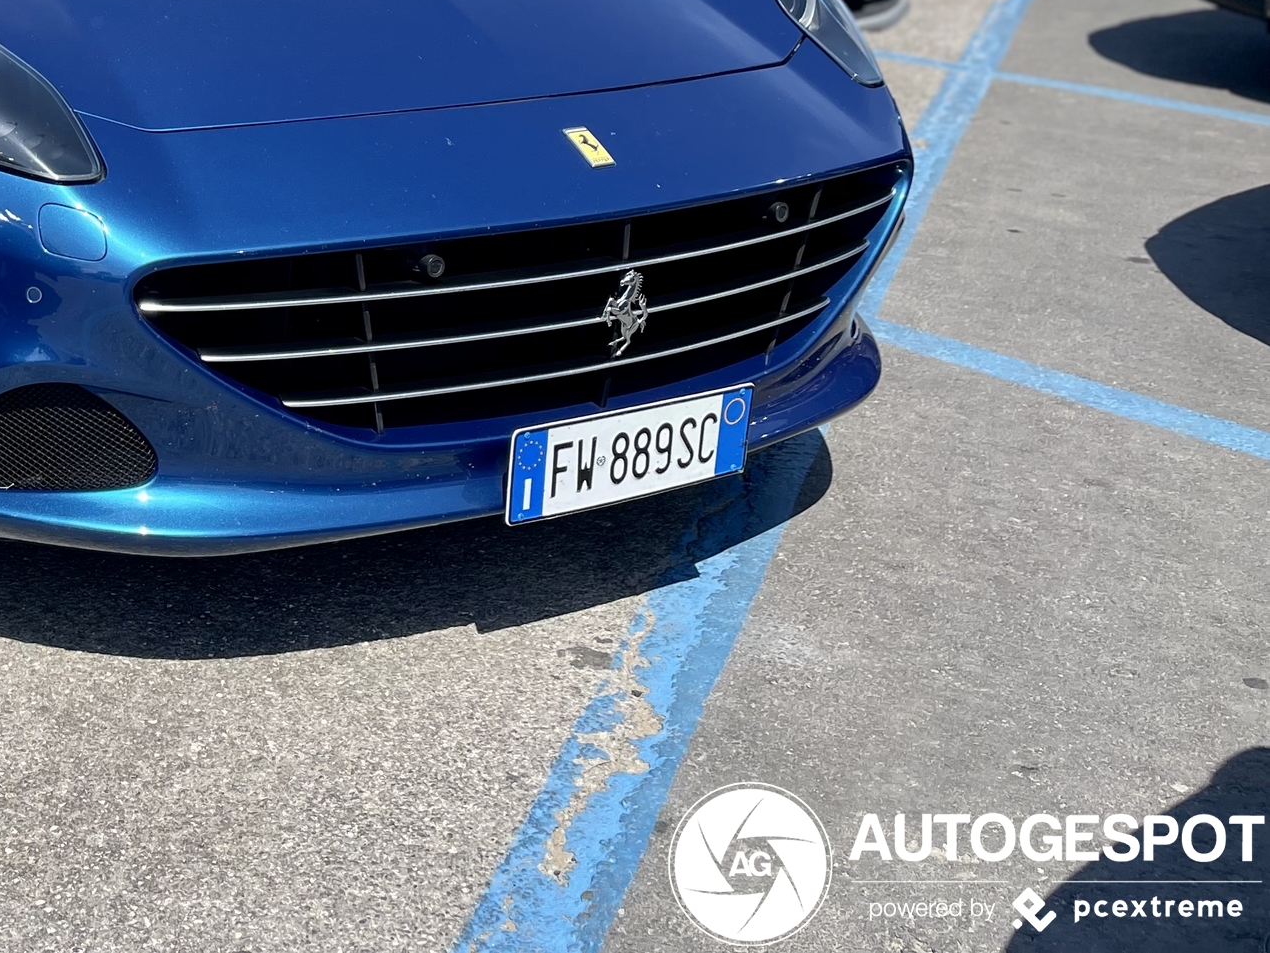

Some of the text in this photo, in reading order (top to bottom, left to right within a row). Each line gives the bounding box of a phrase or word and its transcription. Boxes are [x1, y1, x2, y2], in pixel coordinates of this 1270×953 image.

[522, 412, 718, 511] I FW 889SC
